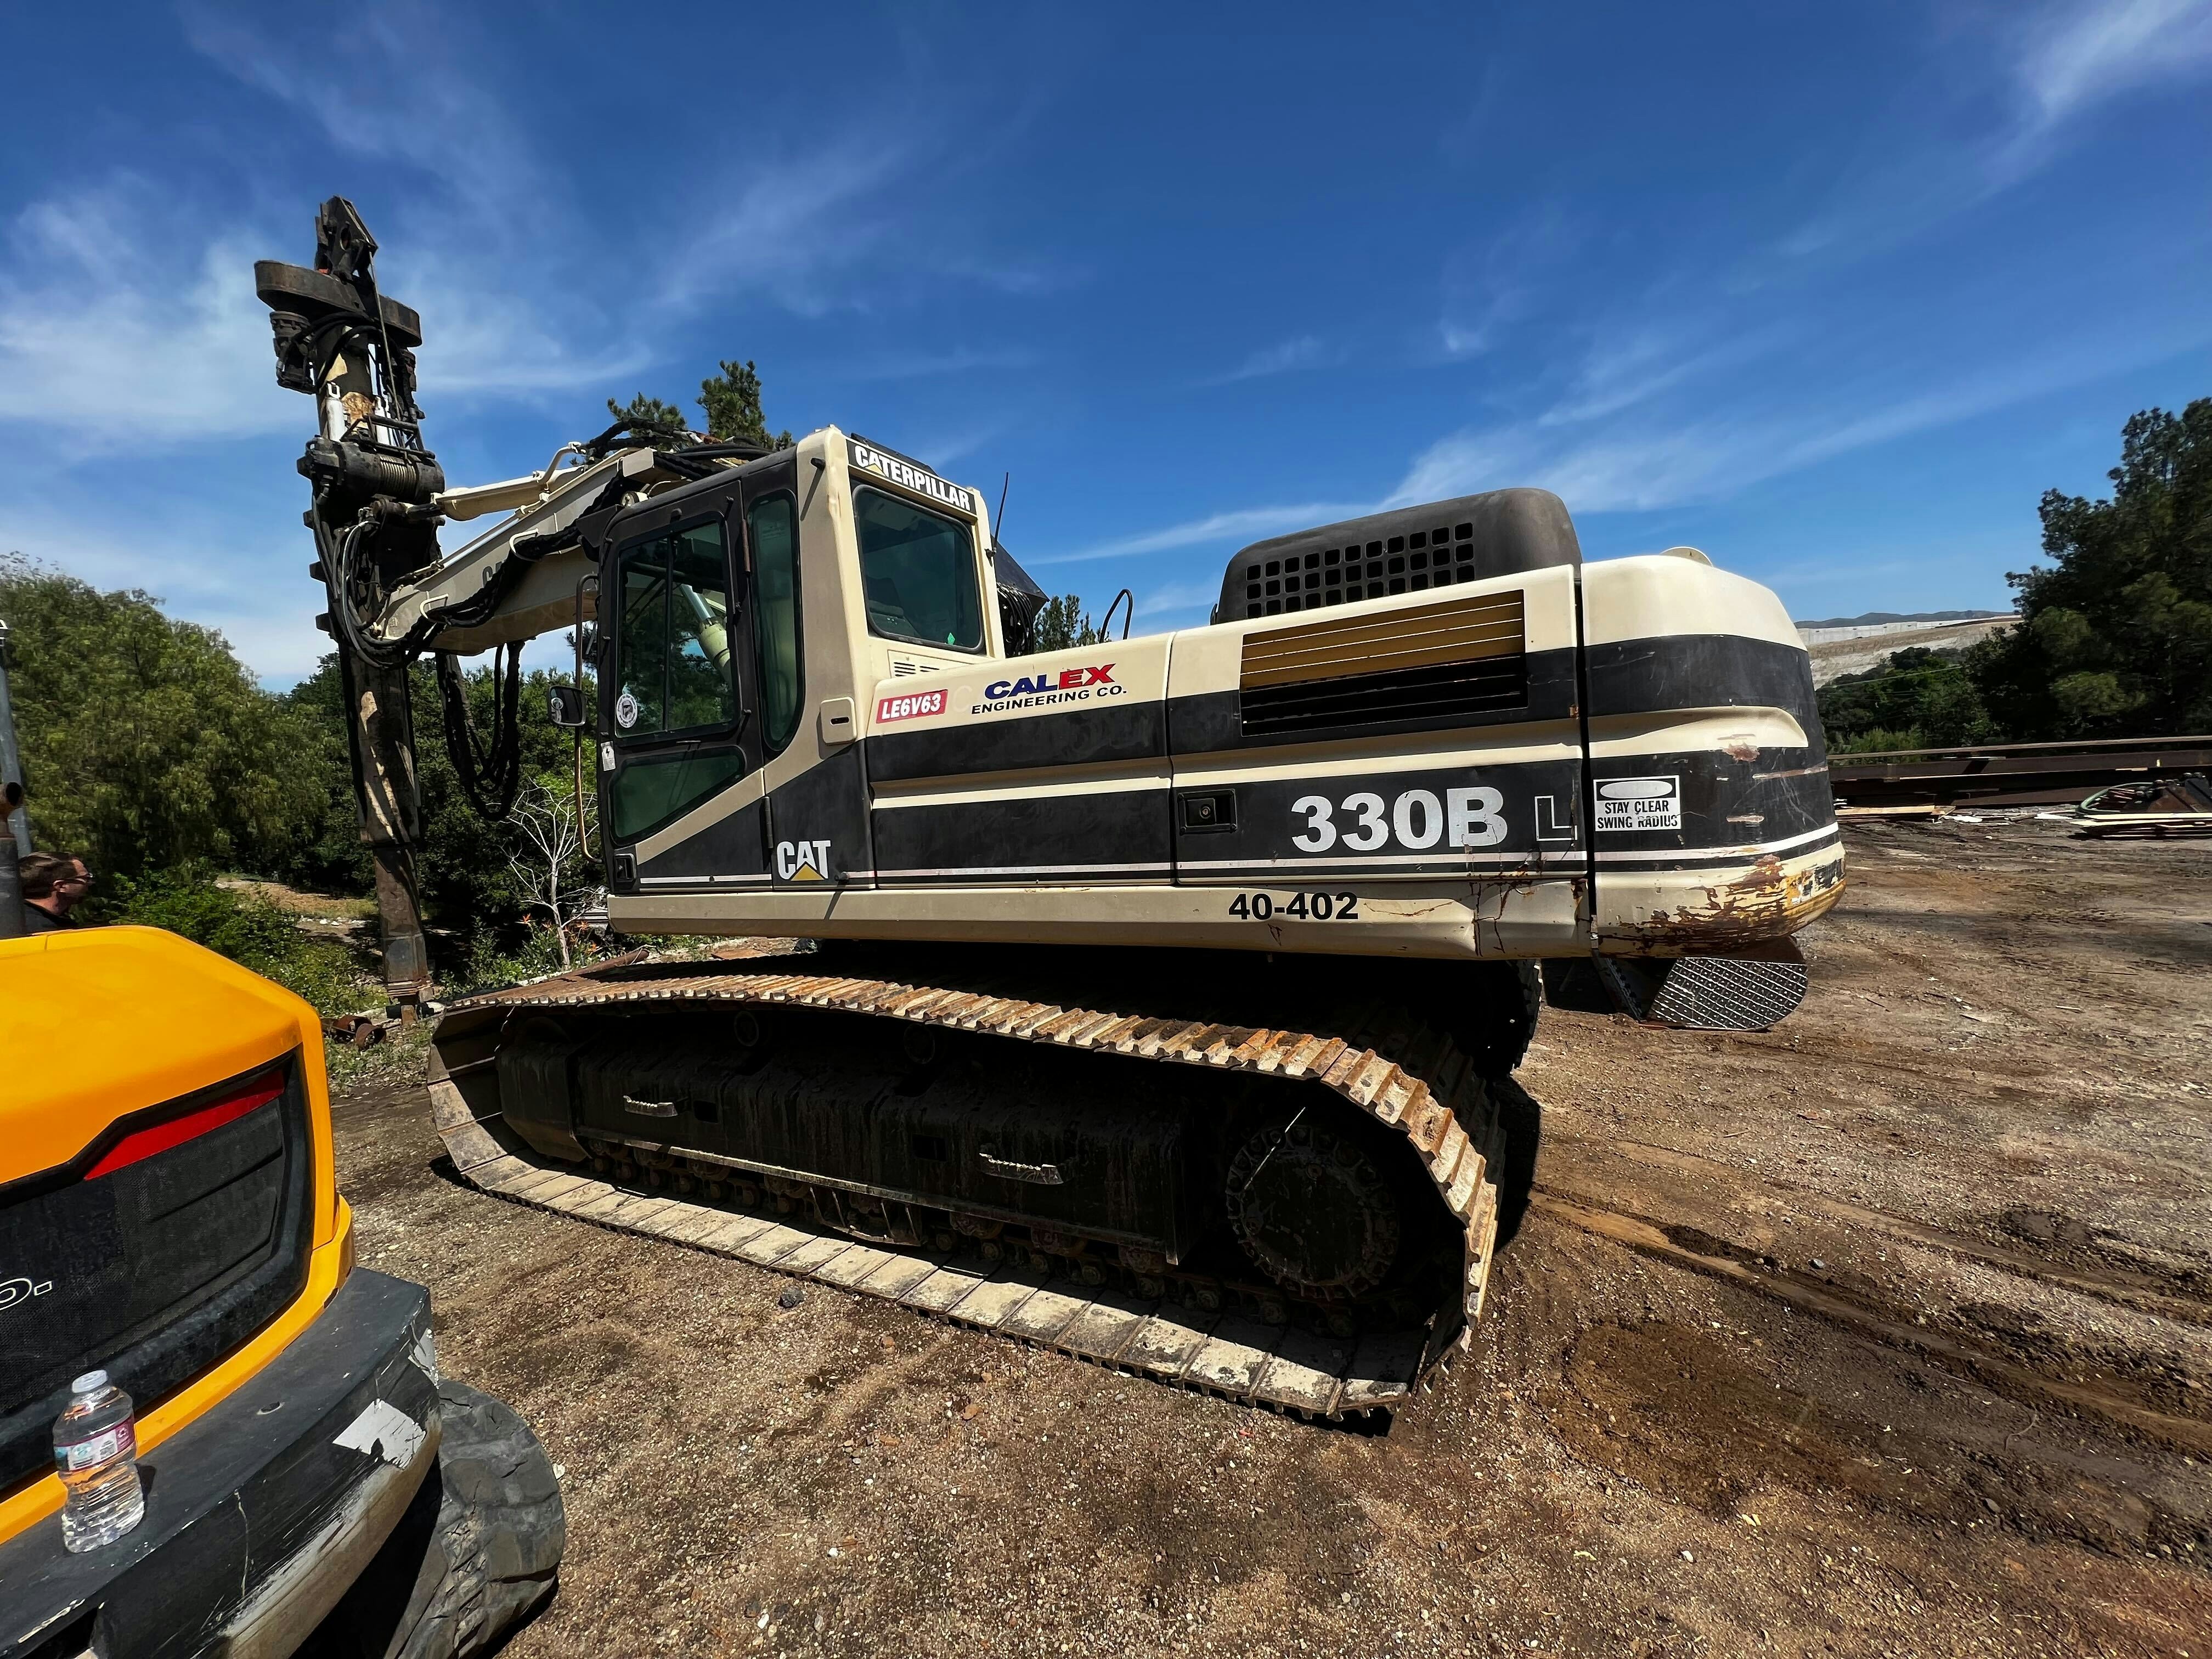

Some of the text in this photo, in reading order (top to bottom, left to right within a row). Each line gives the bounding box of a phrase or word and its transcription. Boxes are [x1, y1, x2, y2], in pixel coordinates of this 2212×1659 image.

[855, 445, 970, 511] CATERPILLAR
[984, 663, 1117, 700] CALEX
[881, 693, 941, 720] LE6V63
[971, 690, 1090, 715] ENGINEERING
[1097, 685, 1127, 698] CO.
[1291, 786, 1578, 853] 330B L
[1597, 815, 1678, 829] SWING RADIUS
[1605, 800, 1669, 814] STAY CLEAR
[777, 840, 831, 880] CAT
[1228, 891, 1359, 921] 40-402
